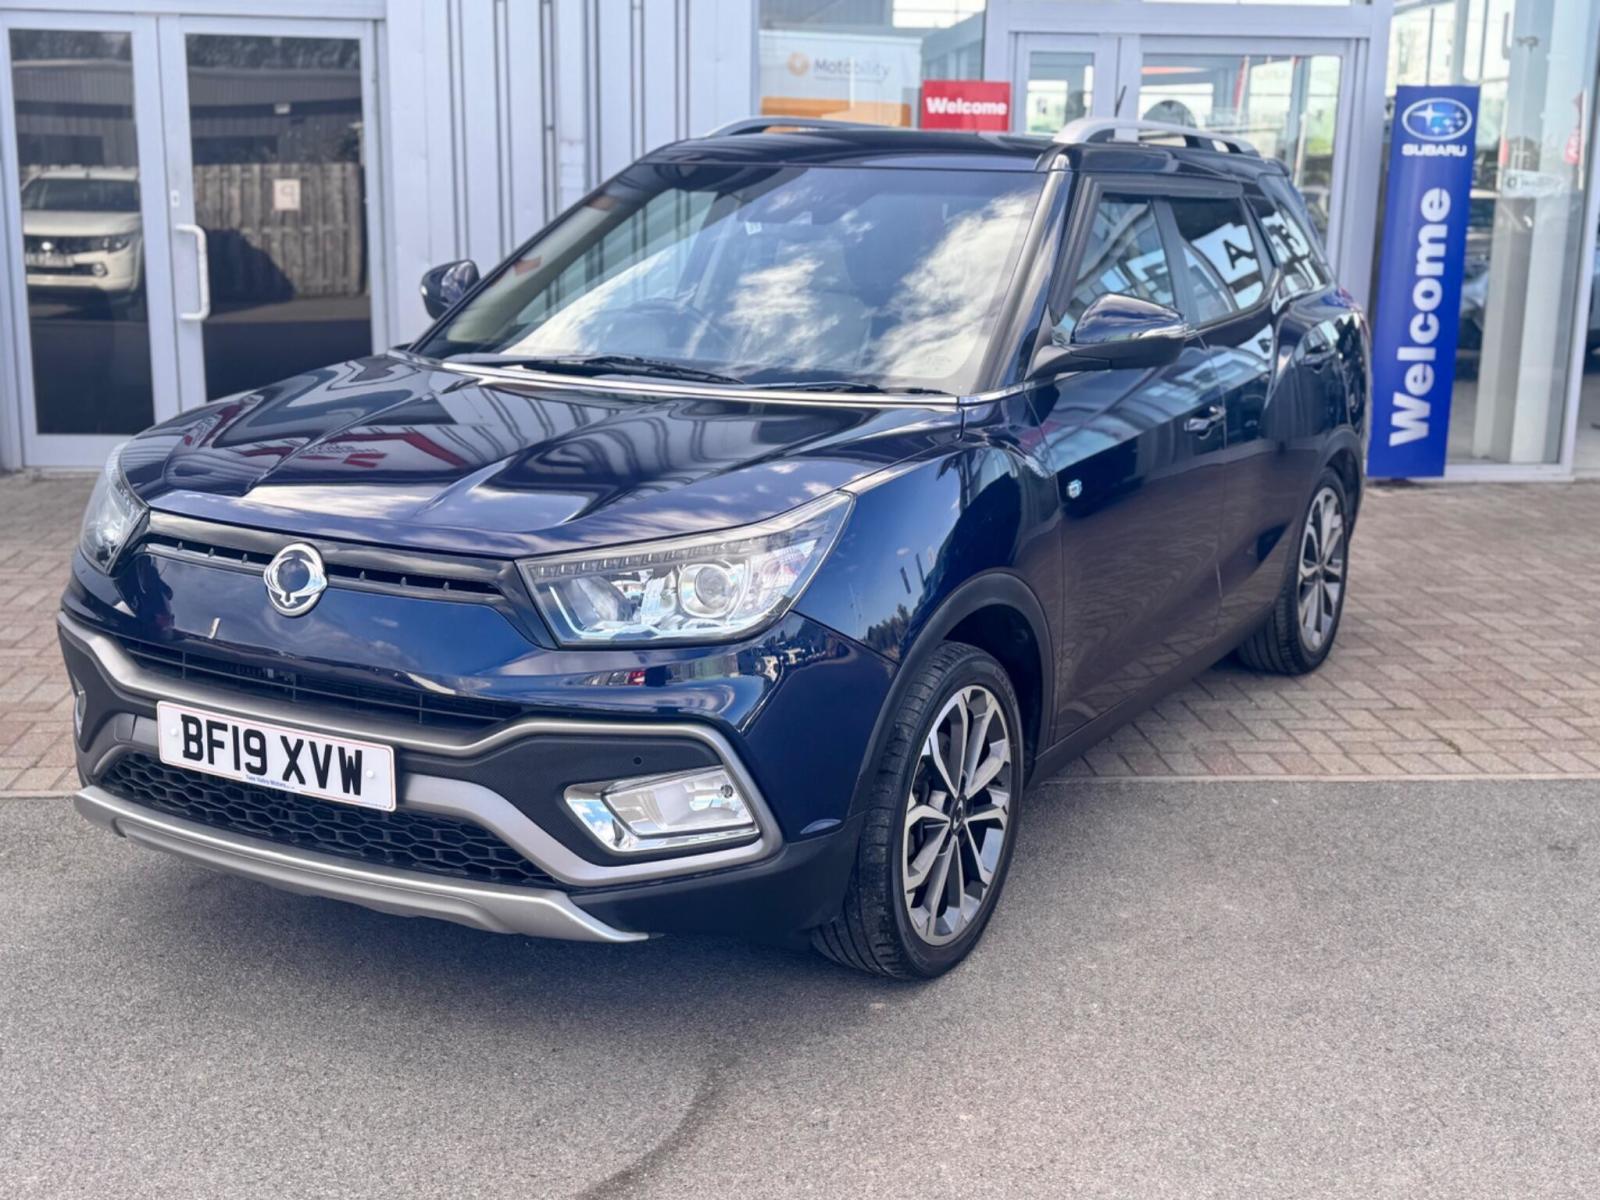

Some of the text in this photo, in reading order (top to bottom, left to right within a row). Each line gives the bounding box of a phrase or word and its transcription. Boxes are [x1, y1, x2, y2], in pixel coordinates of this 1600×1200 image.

[926, 97, 1008, 116] Welcome
[1402, 144, 1467, 157] SUBARU
[1390, 187, 1451, 447] Welcome
[181, 714, 363, 796] BF19 XVW
